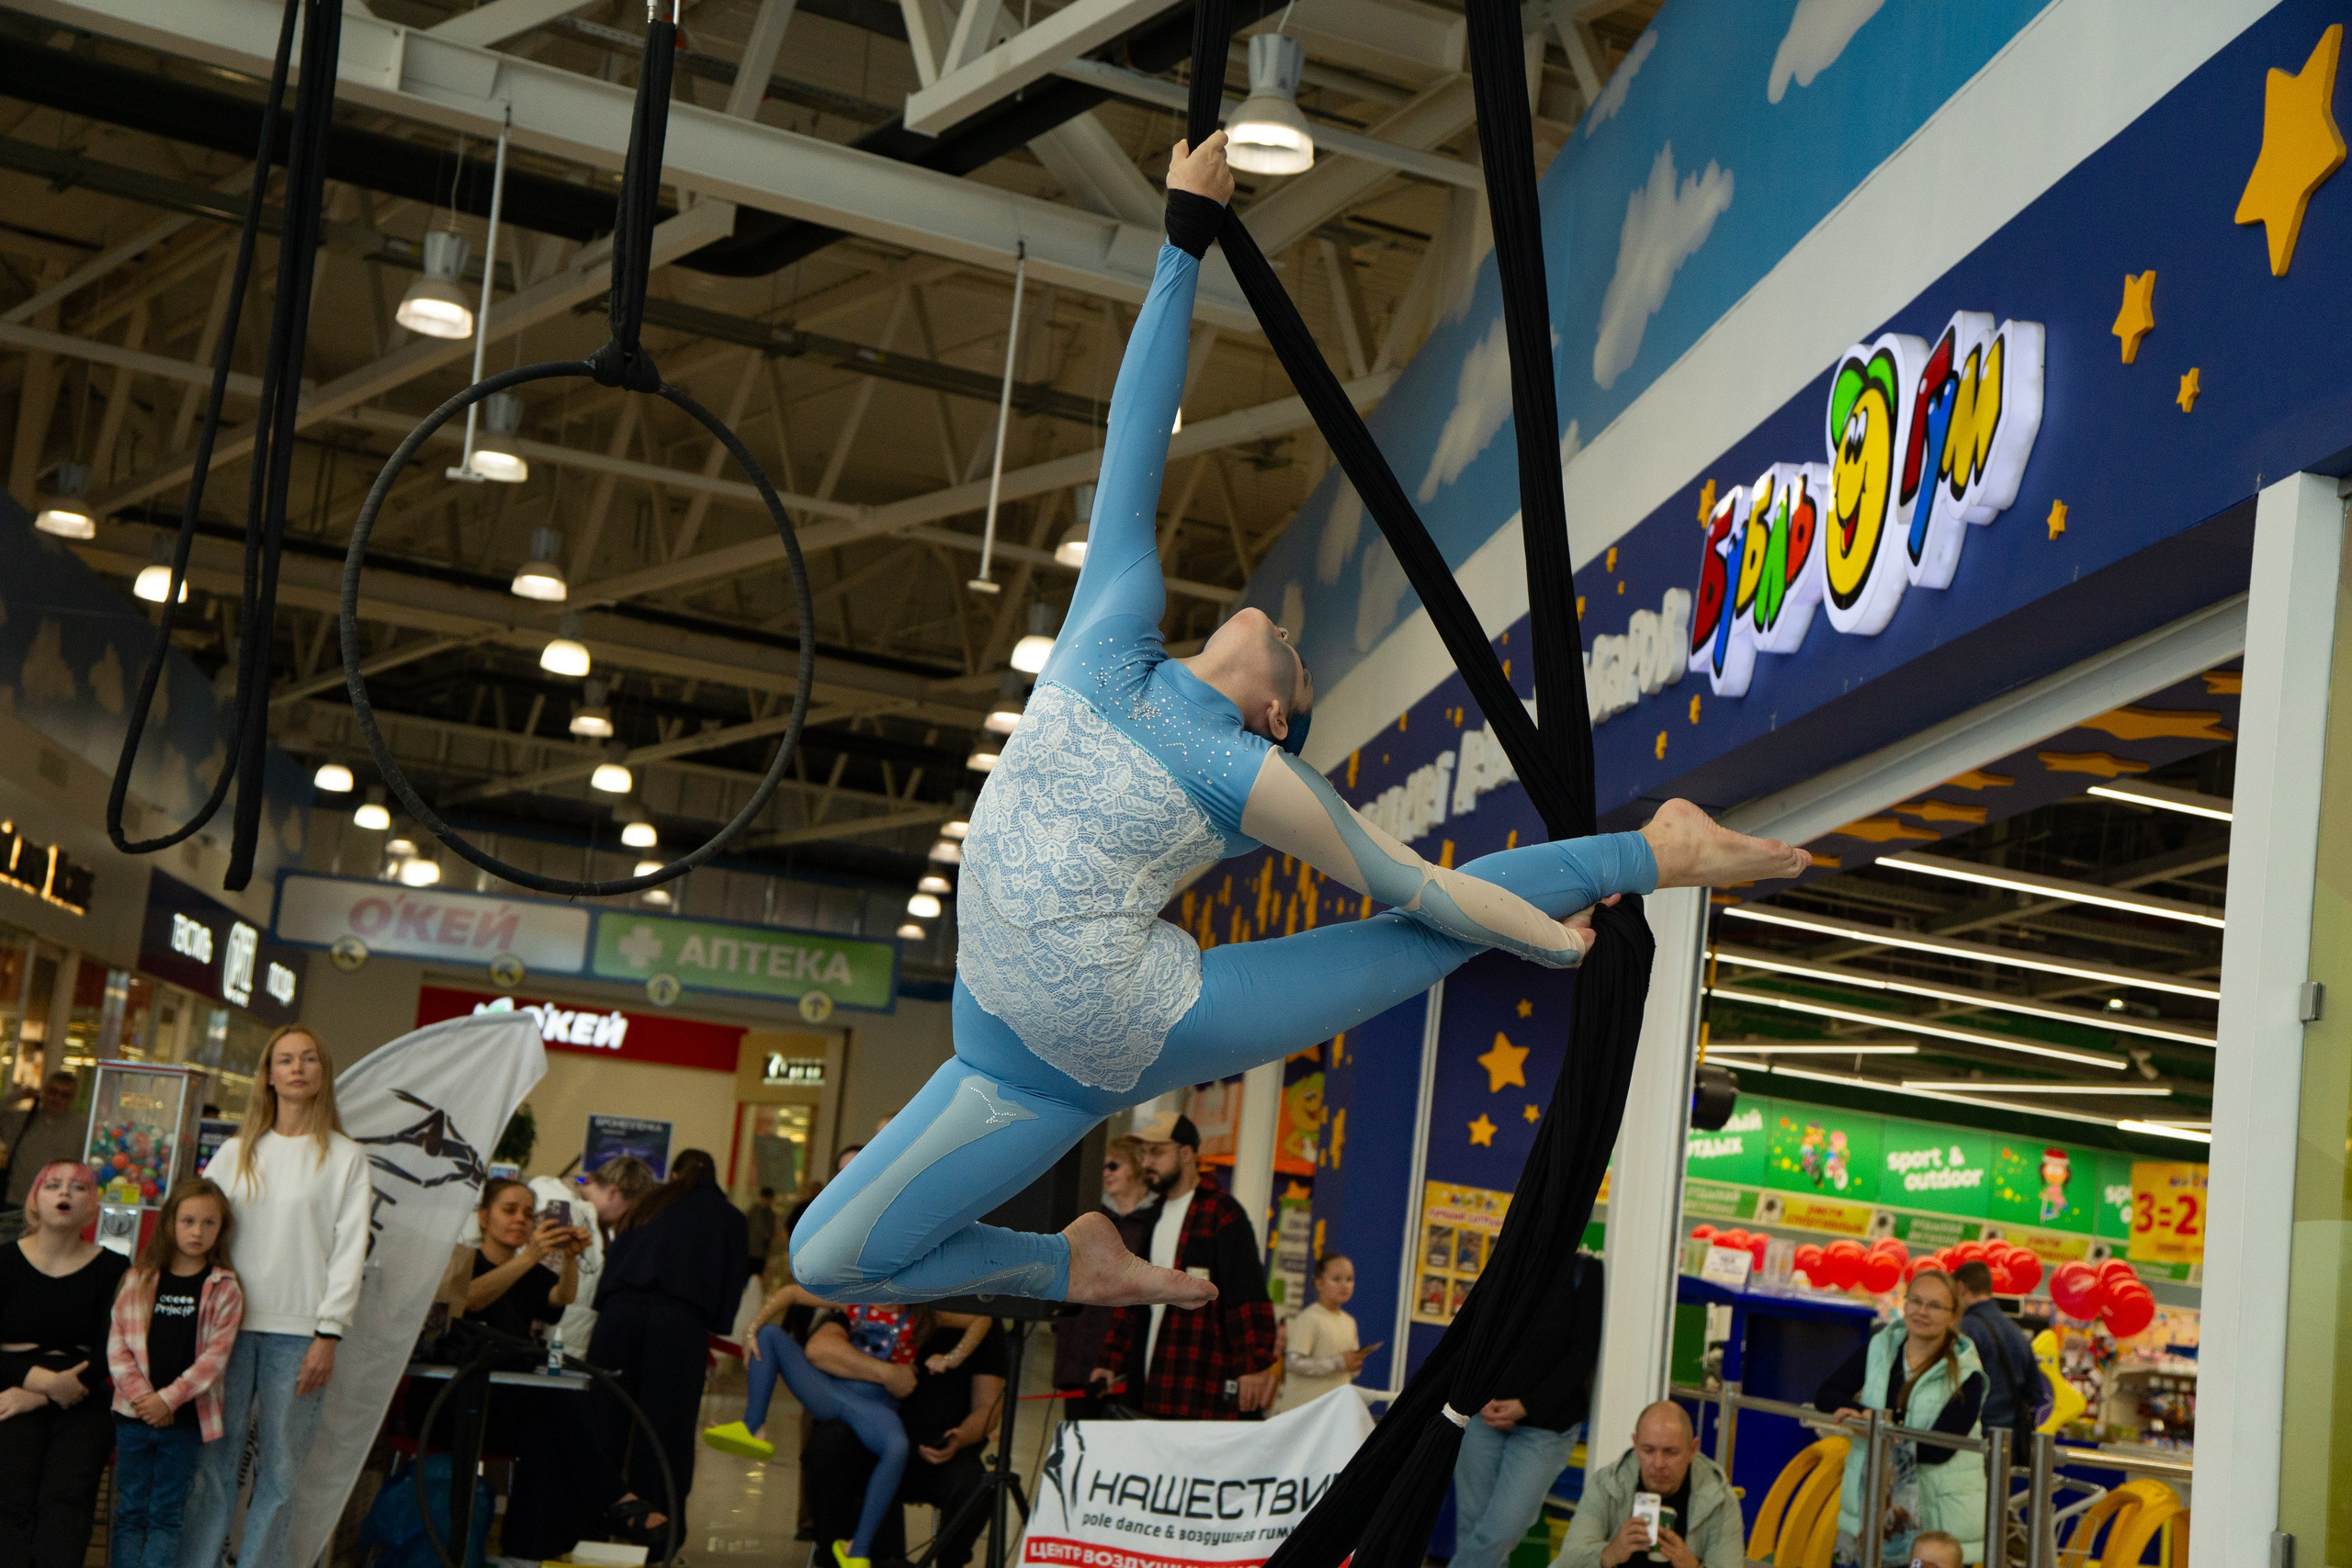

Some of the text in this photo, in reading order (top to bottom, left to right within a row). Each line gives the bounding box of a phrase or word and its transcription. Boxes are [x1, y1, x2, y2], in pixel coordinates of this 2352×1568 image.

[1690, 323, 2007, 682] БУБЛЬ ГУМ
[676, 934, 853, 987] АПТЕКА
[1886, 1145, 1965, 1175] sport &
[1904, 1167, 1984, 1192] outdoor
[1089, 1470, 1340, 1520] НАШЕСТВИ
[1081, 1513, 1295, 1546] pole dance & воздушная гим
[1029, 1542, 1082, 1561] ЦЕНТР
